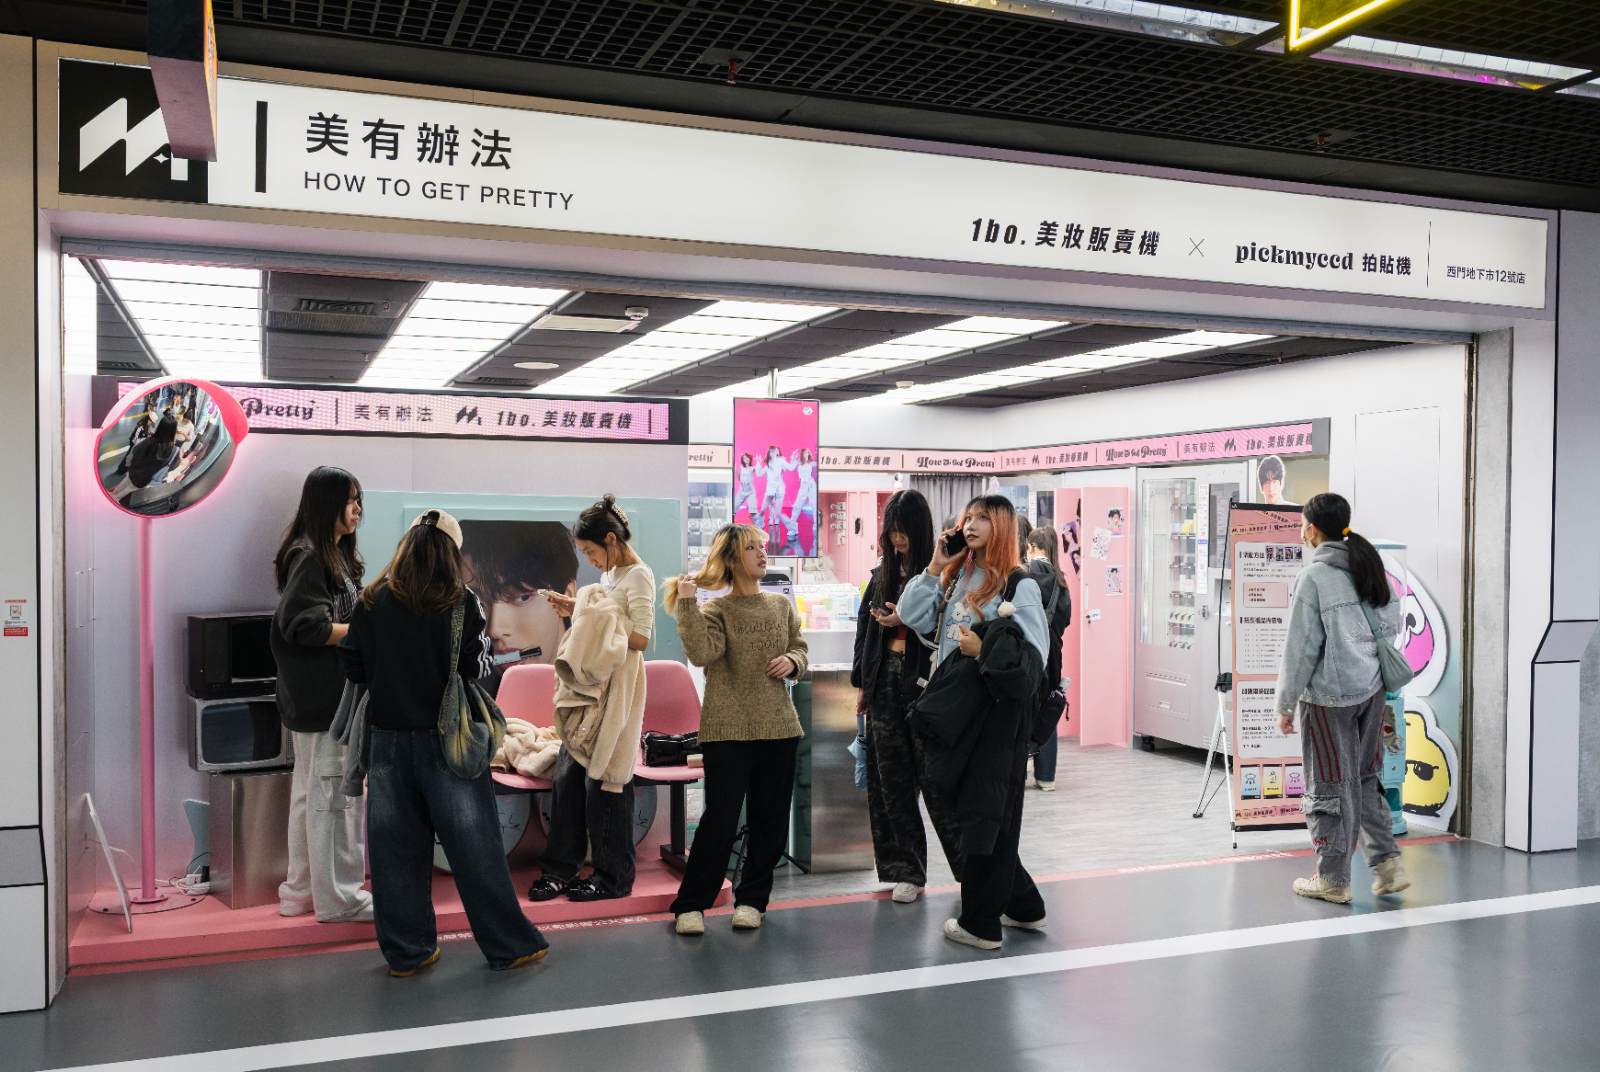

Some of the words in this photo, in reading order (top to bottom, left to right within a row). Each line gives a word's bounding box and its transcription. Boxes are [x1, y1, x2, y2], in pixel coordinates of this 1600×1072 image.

[306, 111, 512, 170] 美有辦法
[304, 171, 366, 193] HOW
[377, 177, 411, 197] TO
[422, 181, 470, 201] GET
[480, 185, 574, 210] PRETTY
[971, 217, 1026, 246] 1bo.
[1035, 220, 1160, 257] 美妝販賣機
[1234, 242, 1354, 270] pickmyccd
[1362, 252, 1412, 276] 拍貼機
[1446, 265, 1526, 284] 西門地下市12號店
[354, 404, 433, 422] 美有辦法
